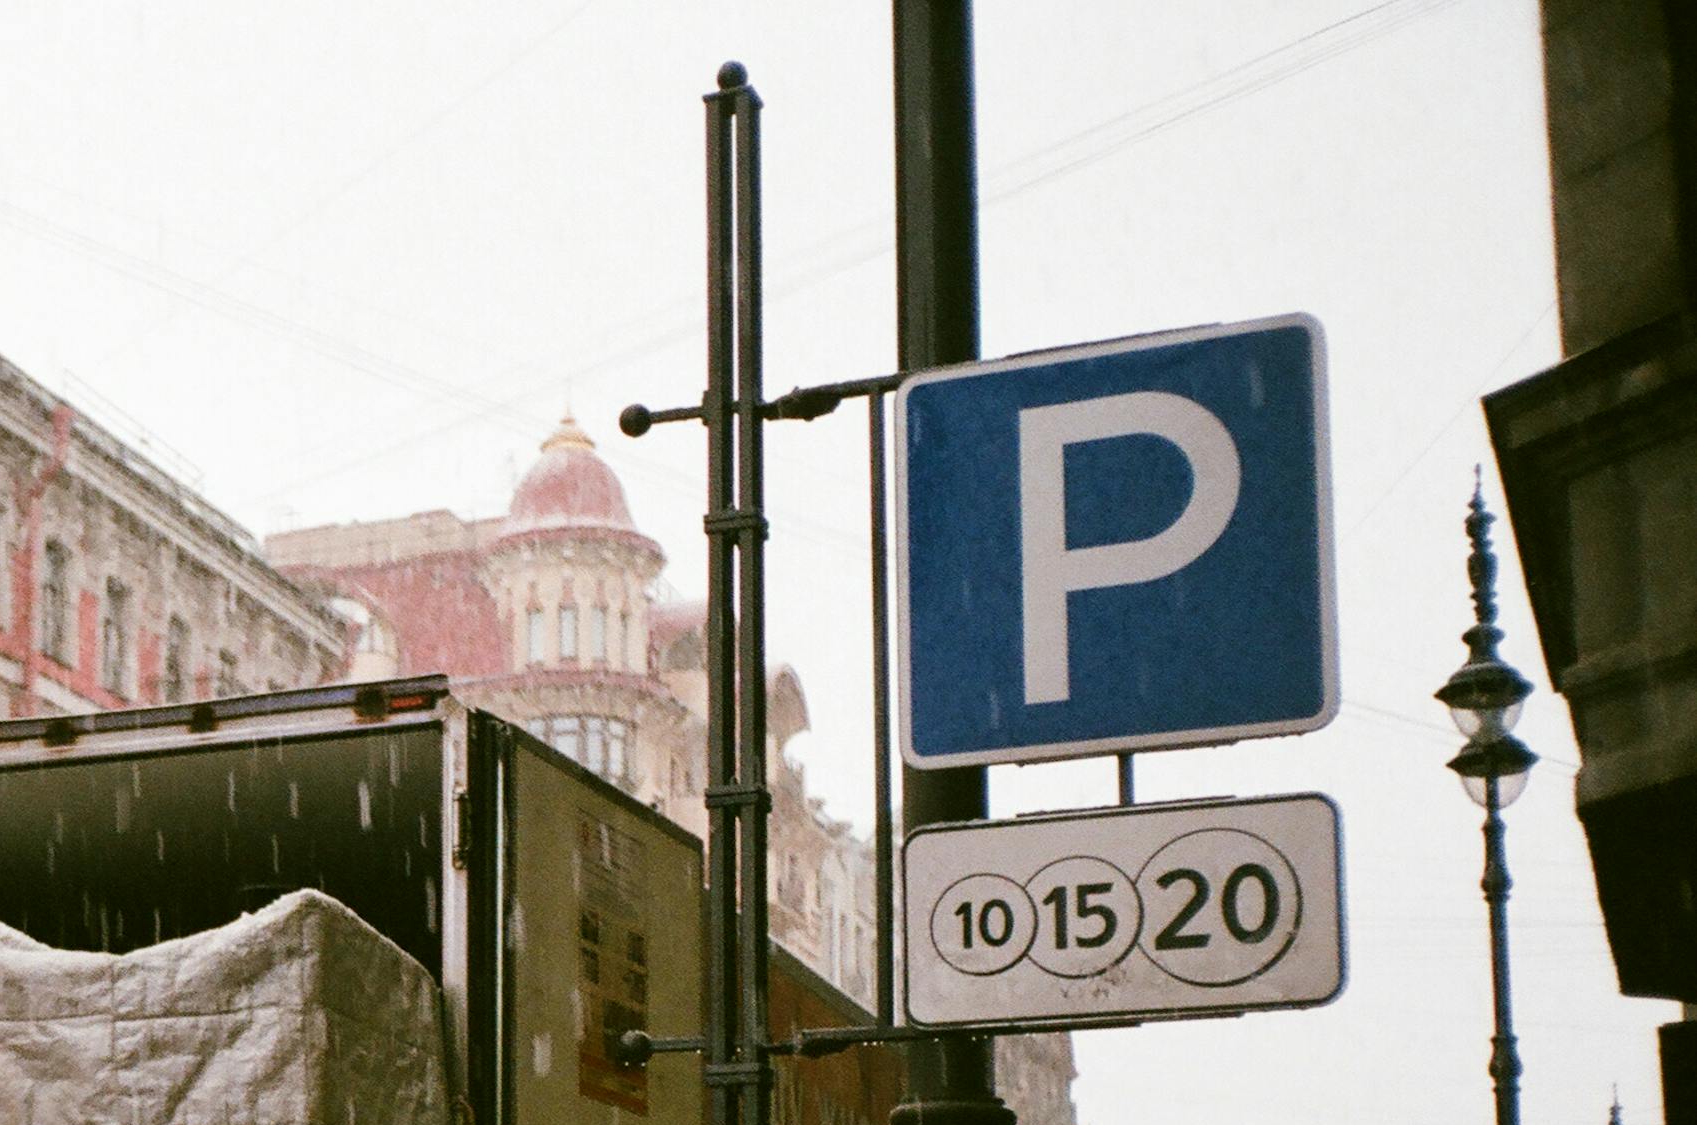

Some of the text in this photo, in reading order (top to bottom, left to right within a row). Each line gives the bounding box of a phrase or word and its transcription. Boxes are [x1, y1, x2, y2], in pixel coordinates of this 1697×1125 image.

[1019, 390, 1241, 705] P
[953, 863, 1281, 951] 10 15 20
